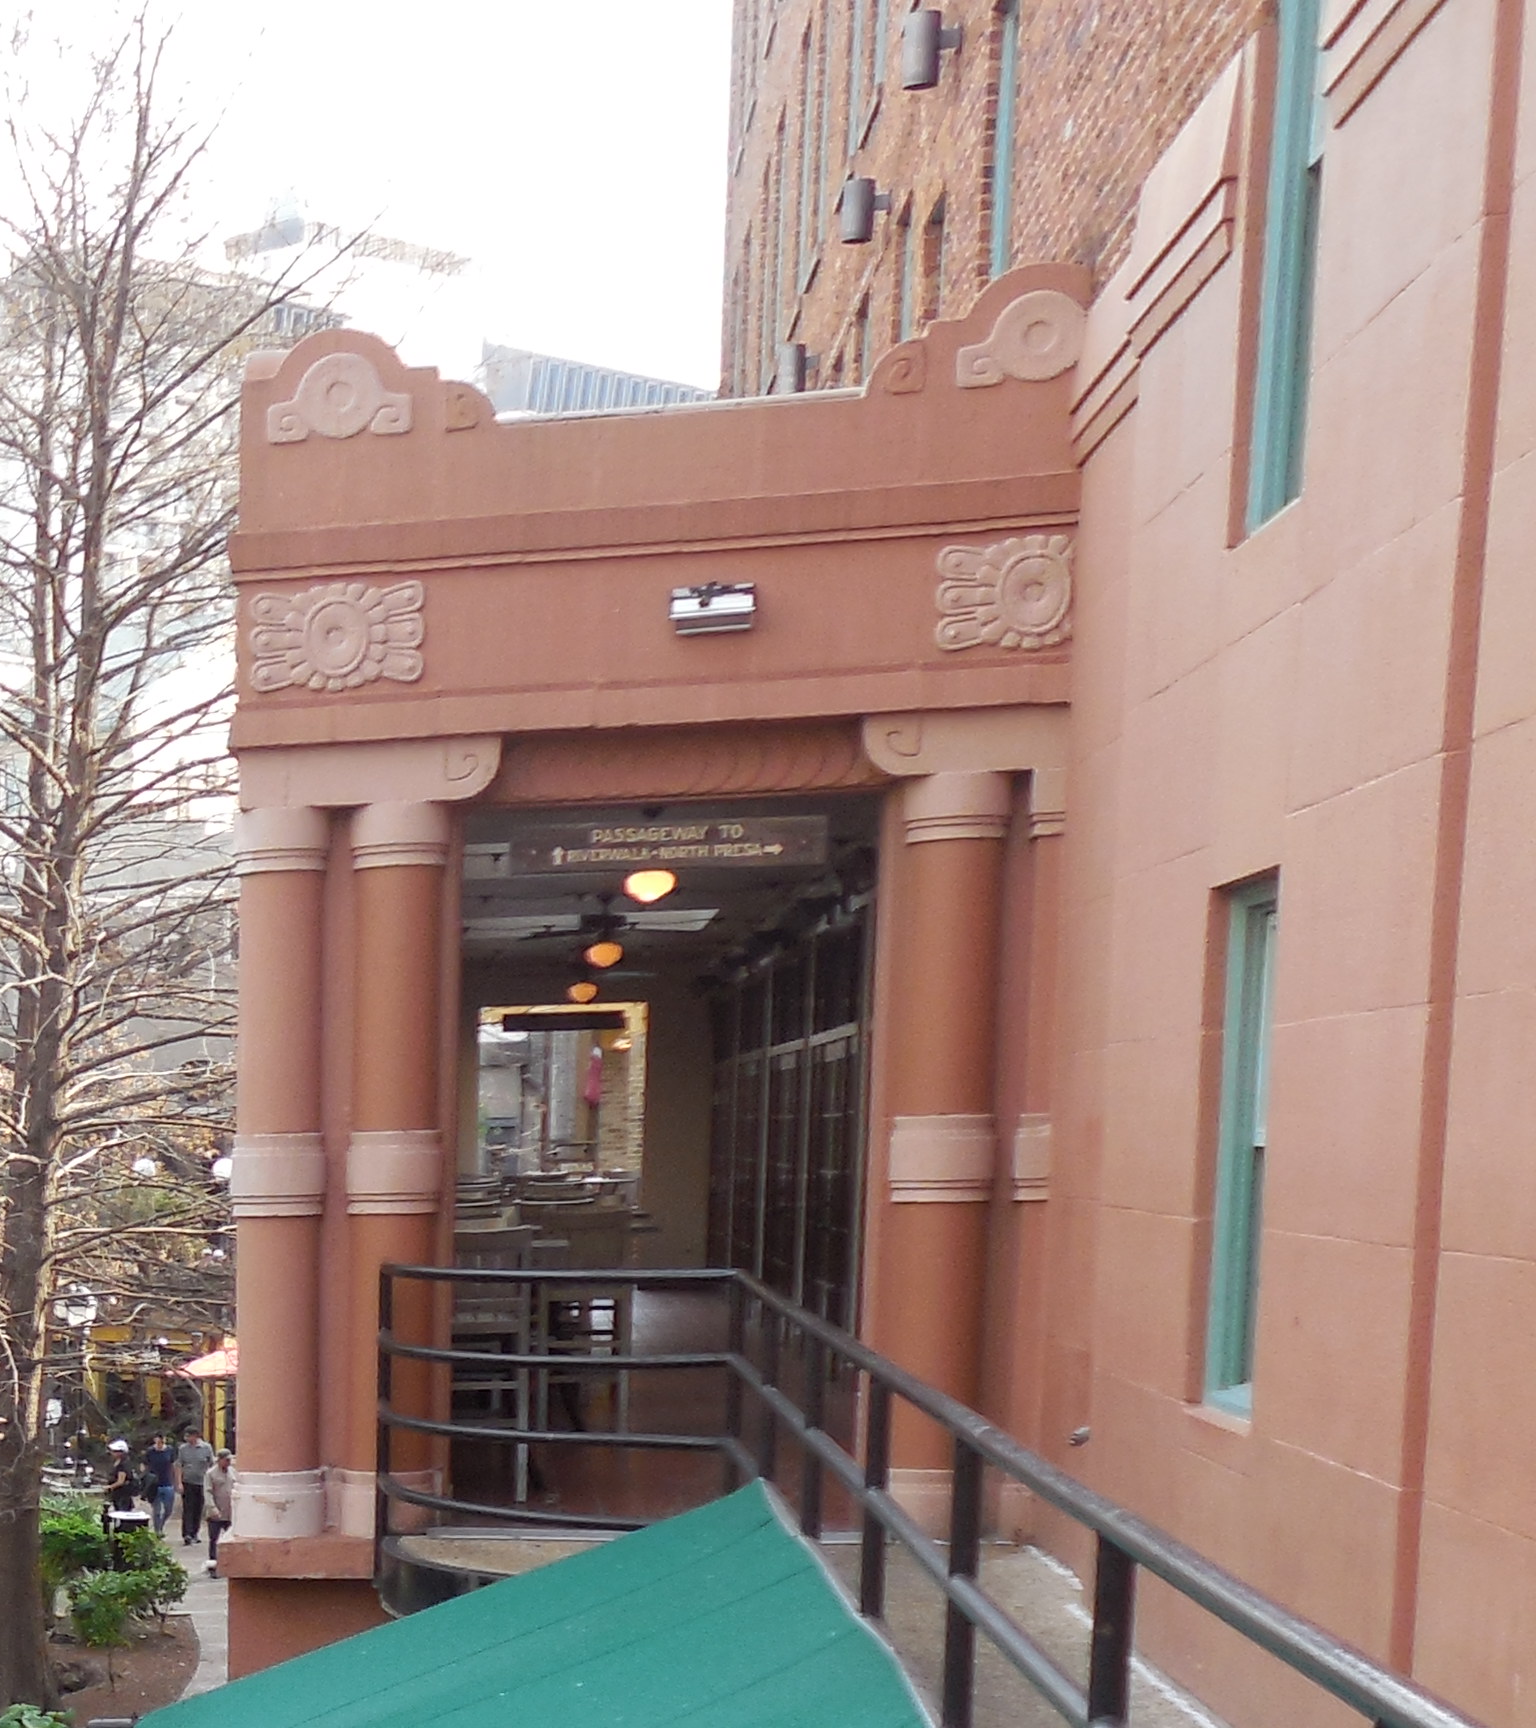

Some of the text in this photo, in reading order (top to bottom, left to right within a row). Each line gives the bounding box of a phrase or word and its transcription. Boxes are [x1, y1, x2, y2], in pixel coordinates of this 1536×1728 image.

[590, 823, 745, 843] PASSAGEWAY TO
[713, 842, 763, 858] PRESA
